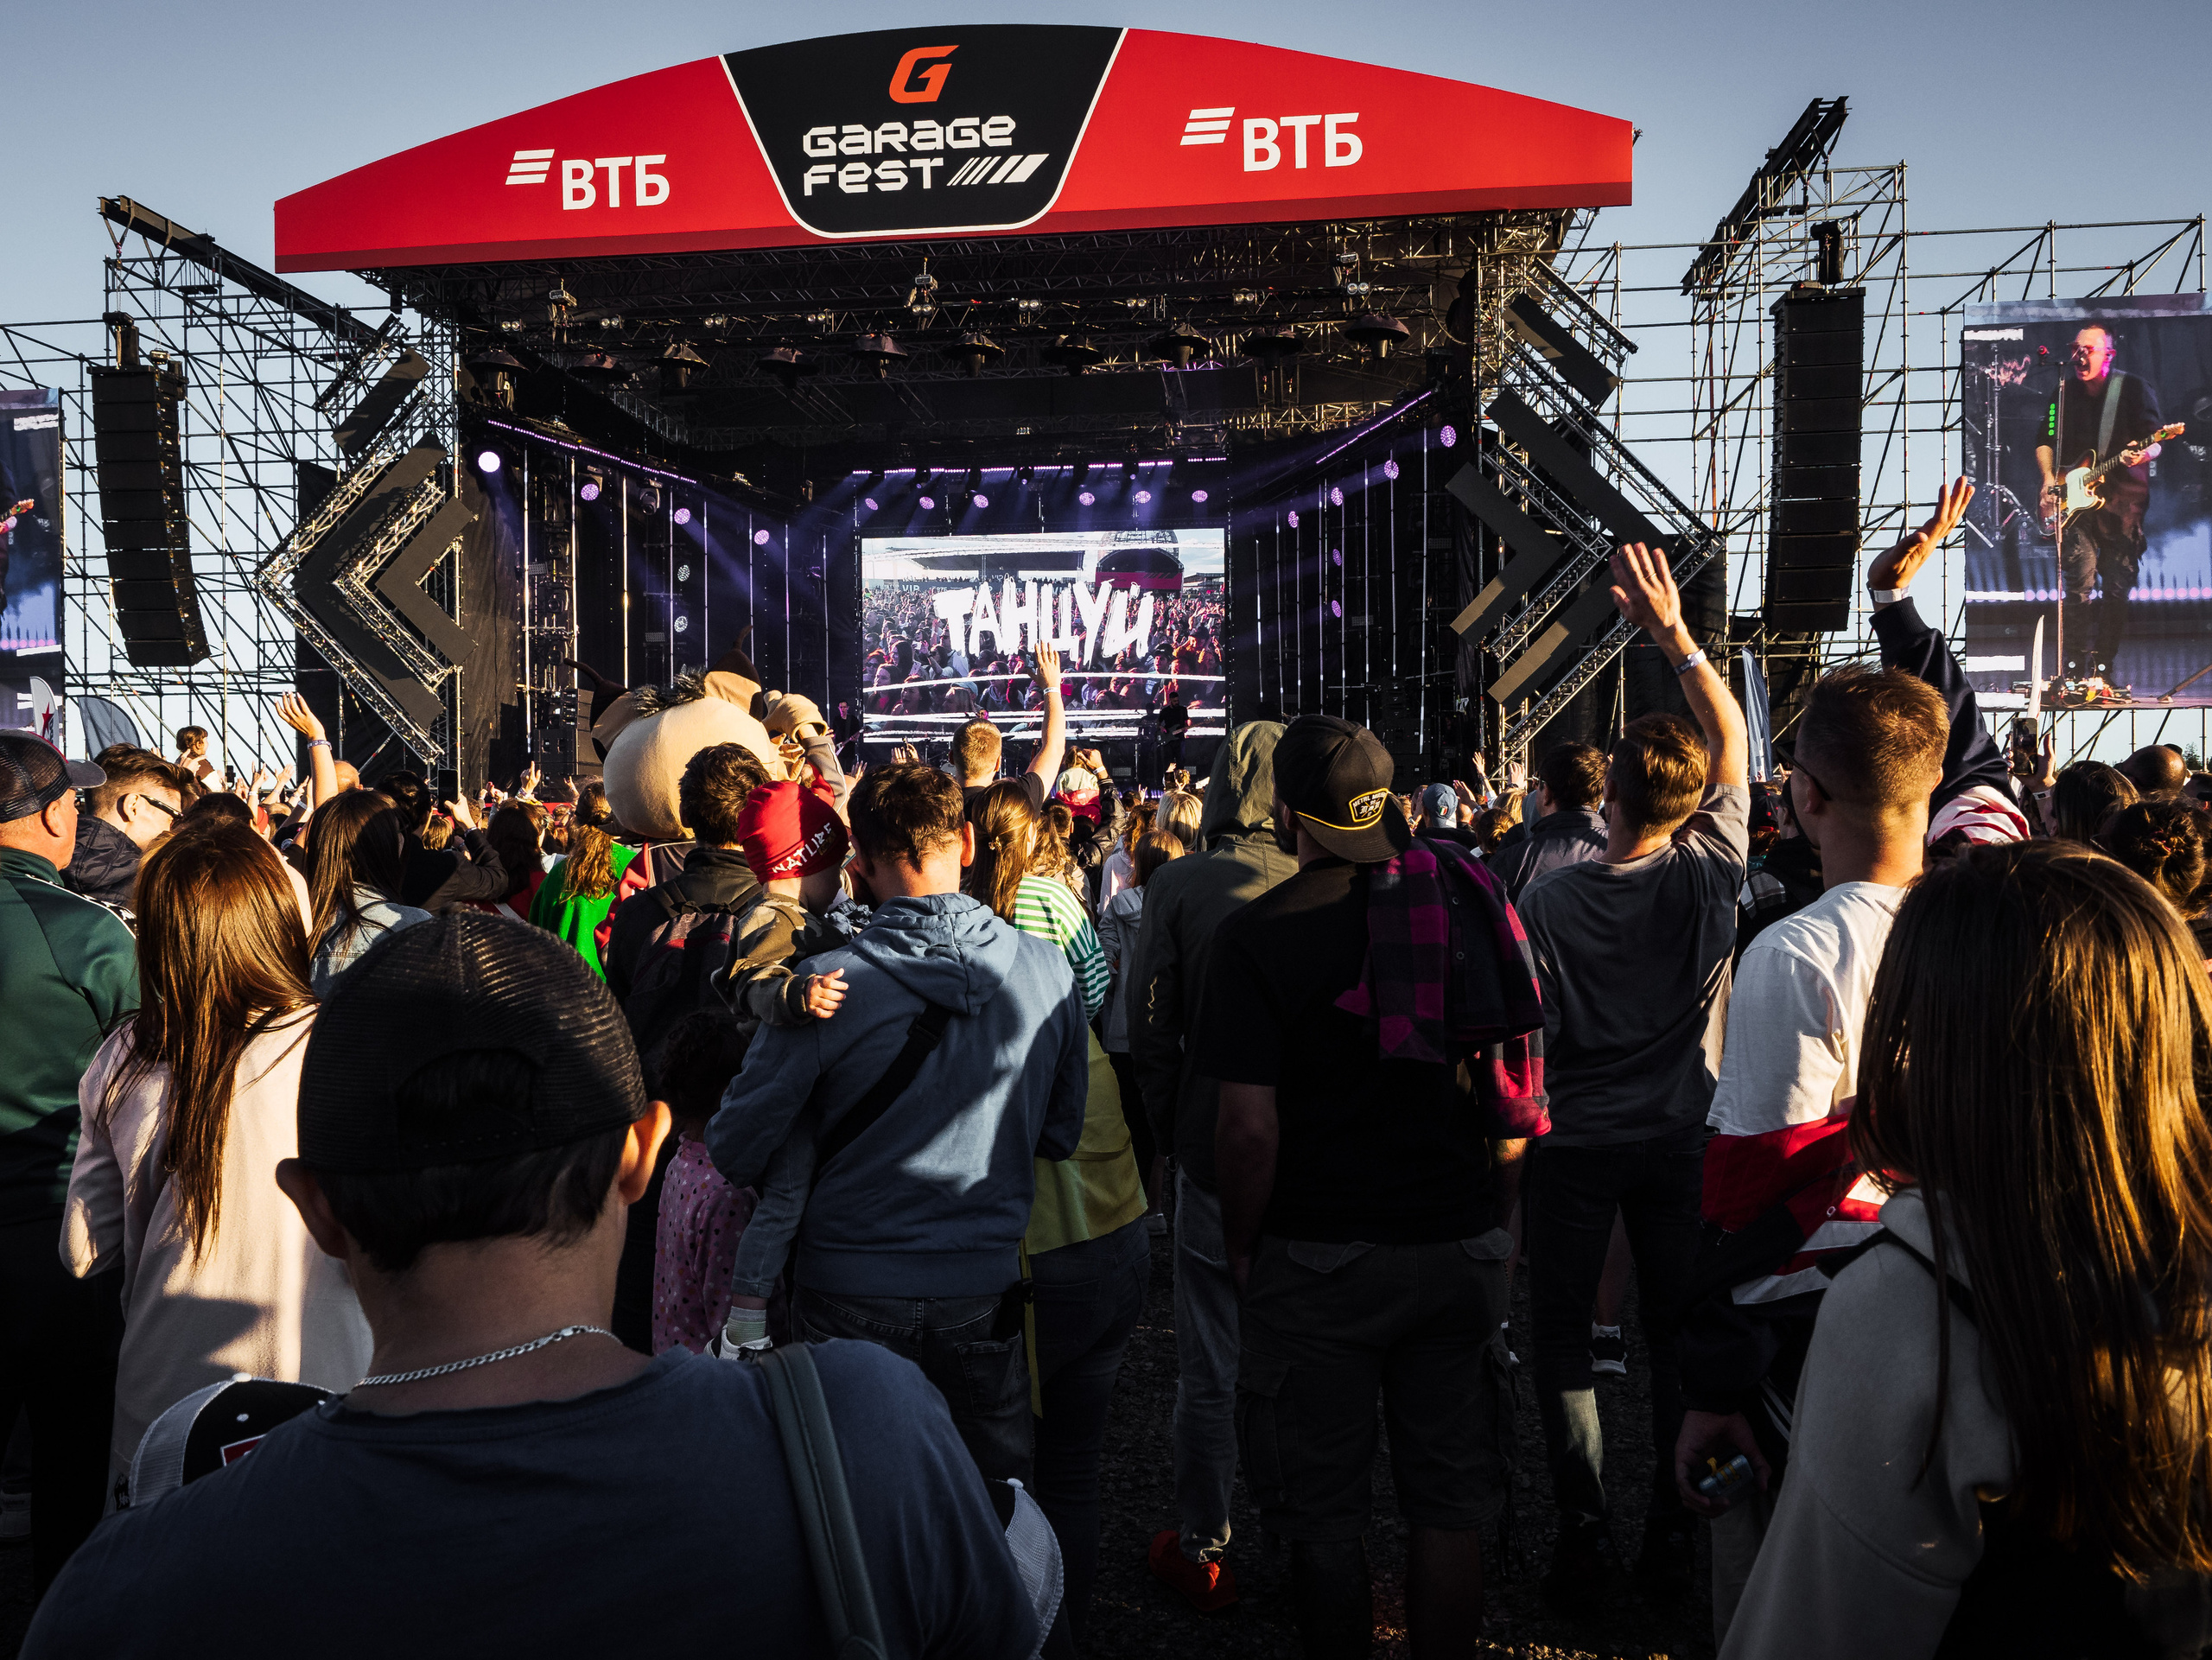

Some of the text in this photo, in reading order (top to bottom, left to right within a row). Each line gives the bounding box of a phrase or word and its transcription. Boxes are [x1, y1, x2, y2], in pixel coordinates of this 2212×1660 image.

[1243, 112, 1363, 172] ВТБ
[562, 154, 671, 210] ВТБ
[902, 584, 920, 593] VIP
[932, 573, 1155, 670] ТАНЦУЙ
